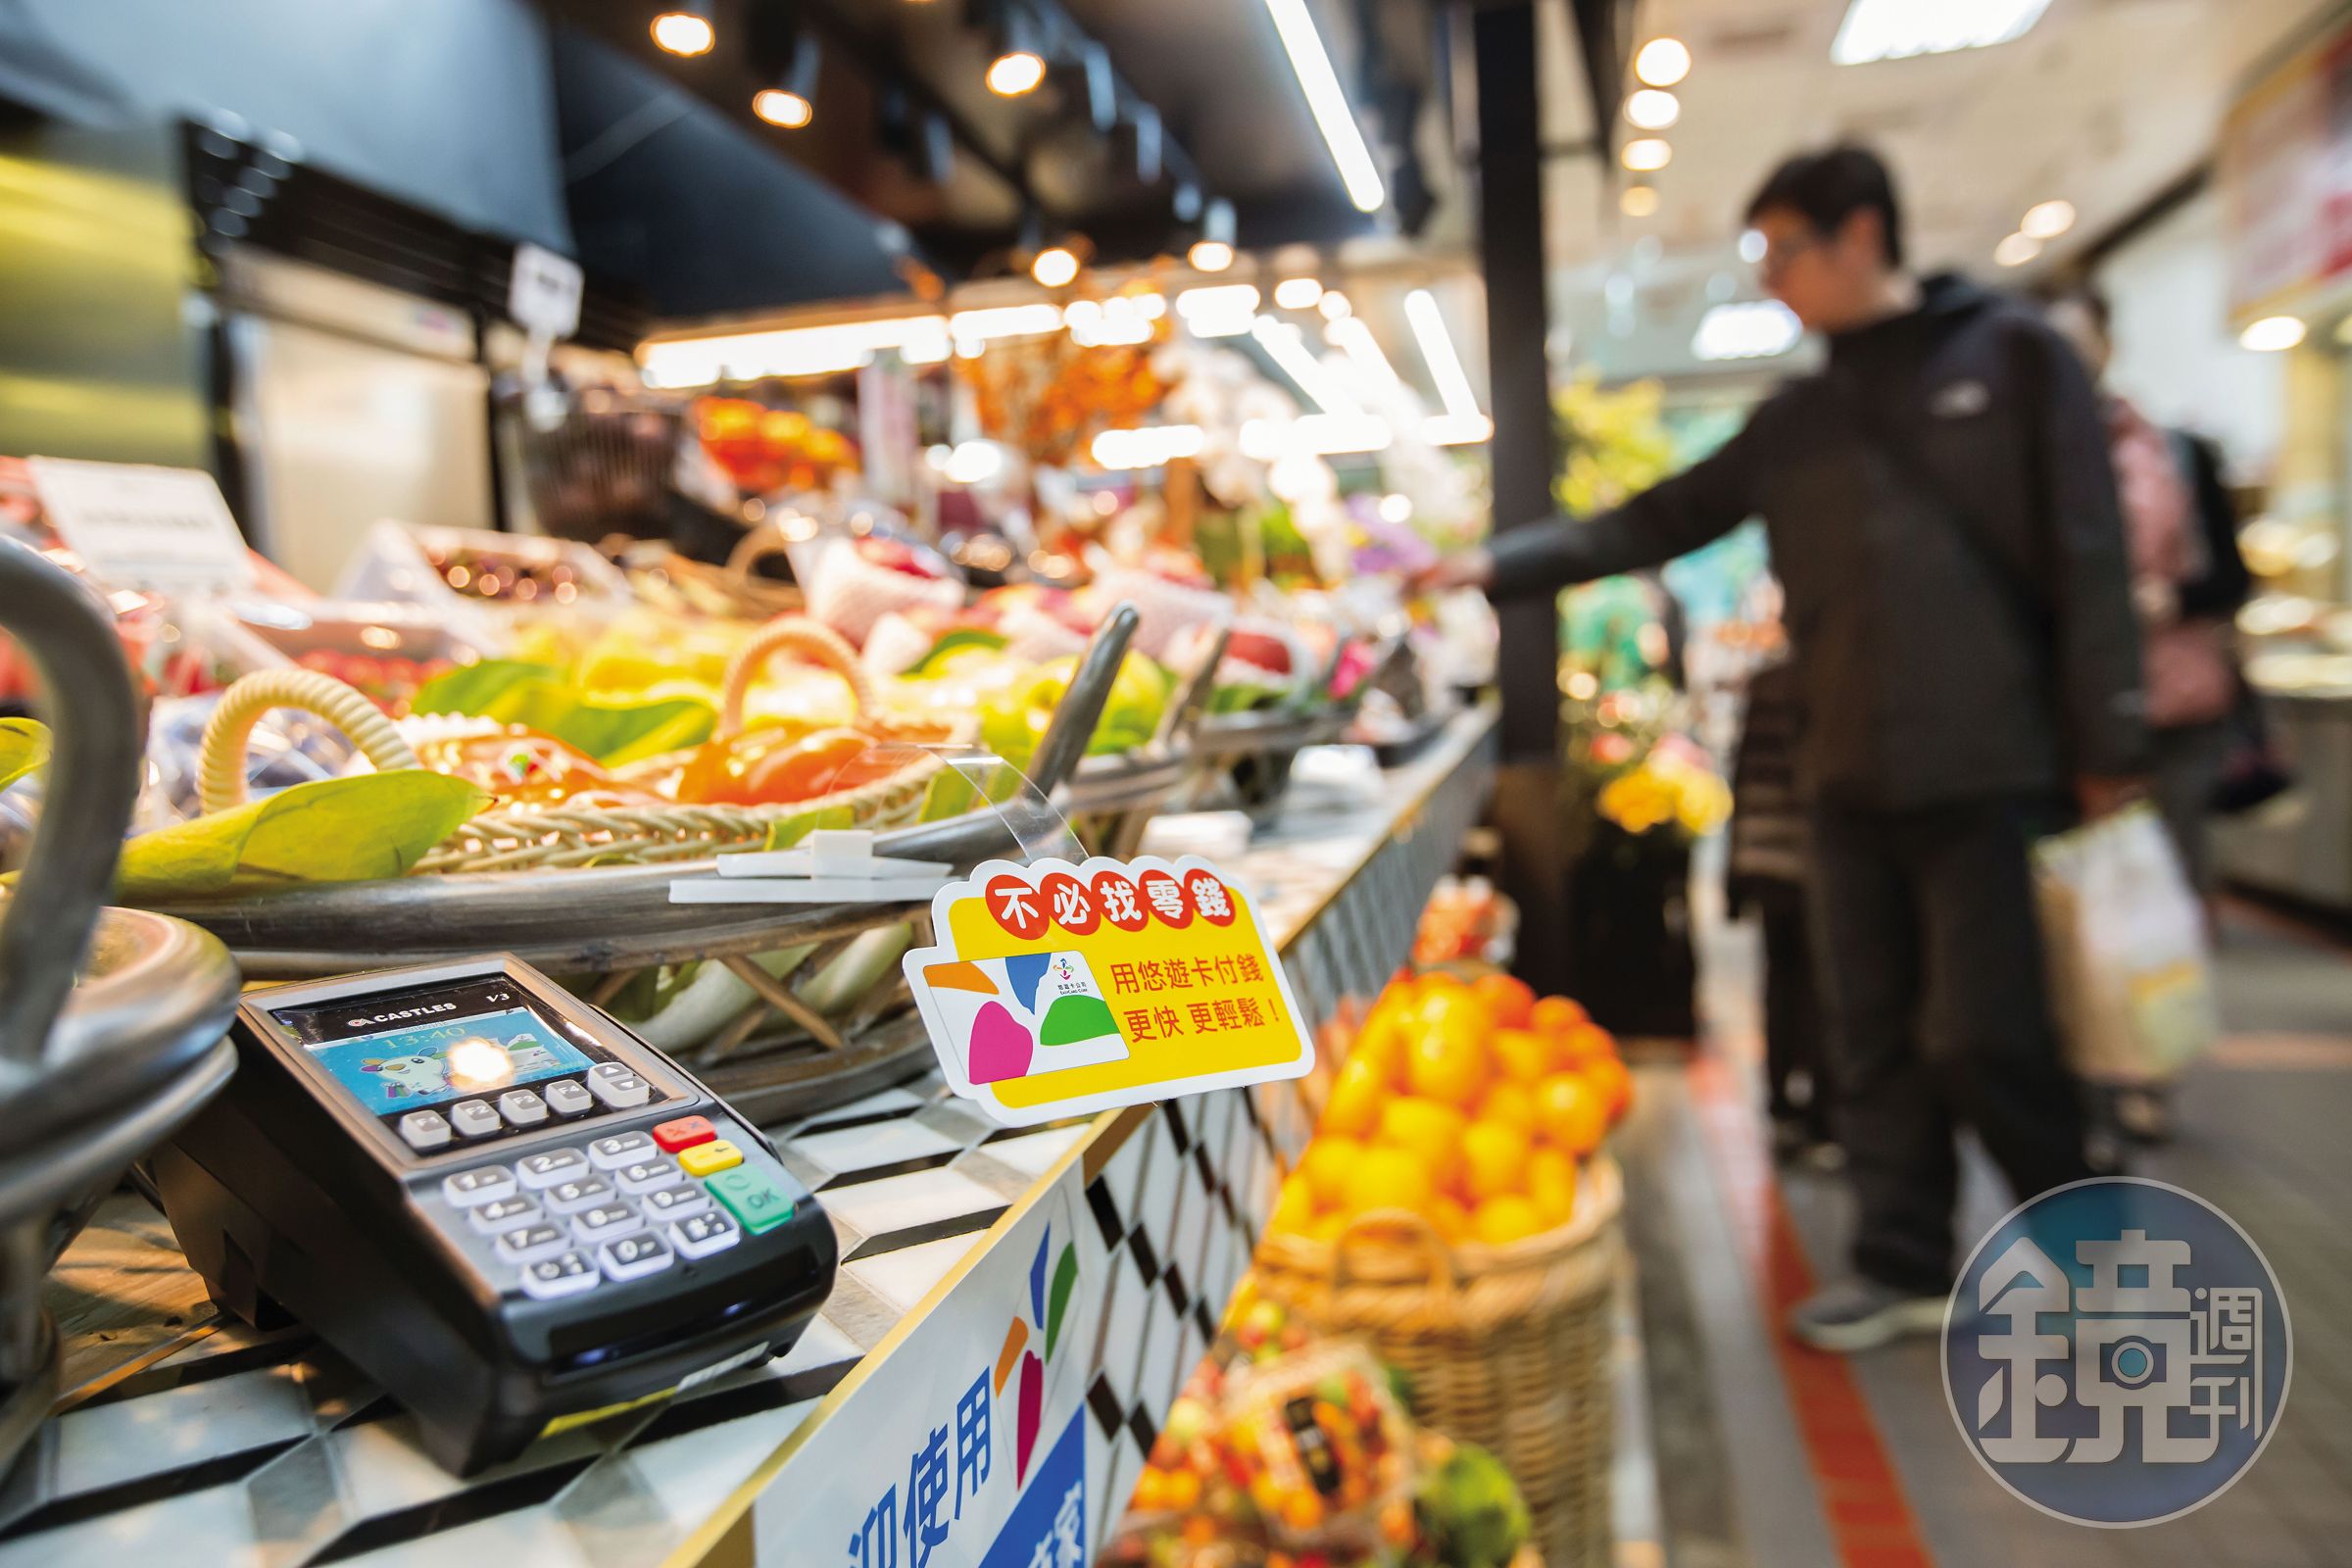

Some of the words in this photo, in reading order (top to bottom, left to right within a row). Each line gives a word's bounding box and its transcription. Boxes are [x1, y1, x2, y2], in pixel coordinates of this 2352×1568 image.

[994, 877, 1231, 929] 不必找零錢
[1109, 953, 1264, 996] 用悠遊卡付錢
[373, 1003, 457, 1023] CASTLES
[486, 993, 510, 1004] V3
[1123, 1005, 1185, 1044] 更快
[465, 1105, 489, 1116] F2
[513, 1095, 535, 1105] F3
[558, 1085, 580, 1095] F4
[747, 1187, 780, 1209] OK
